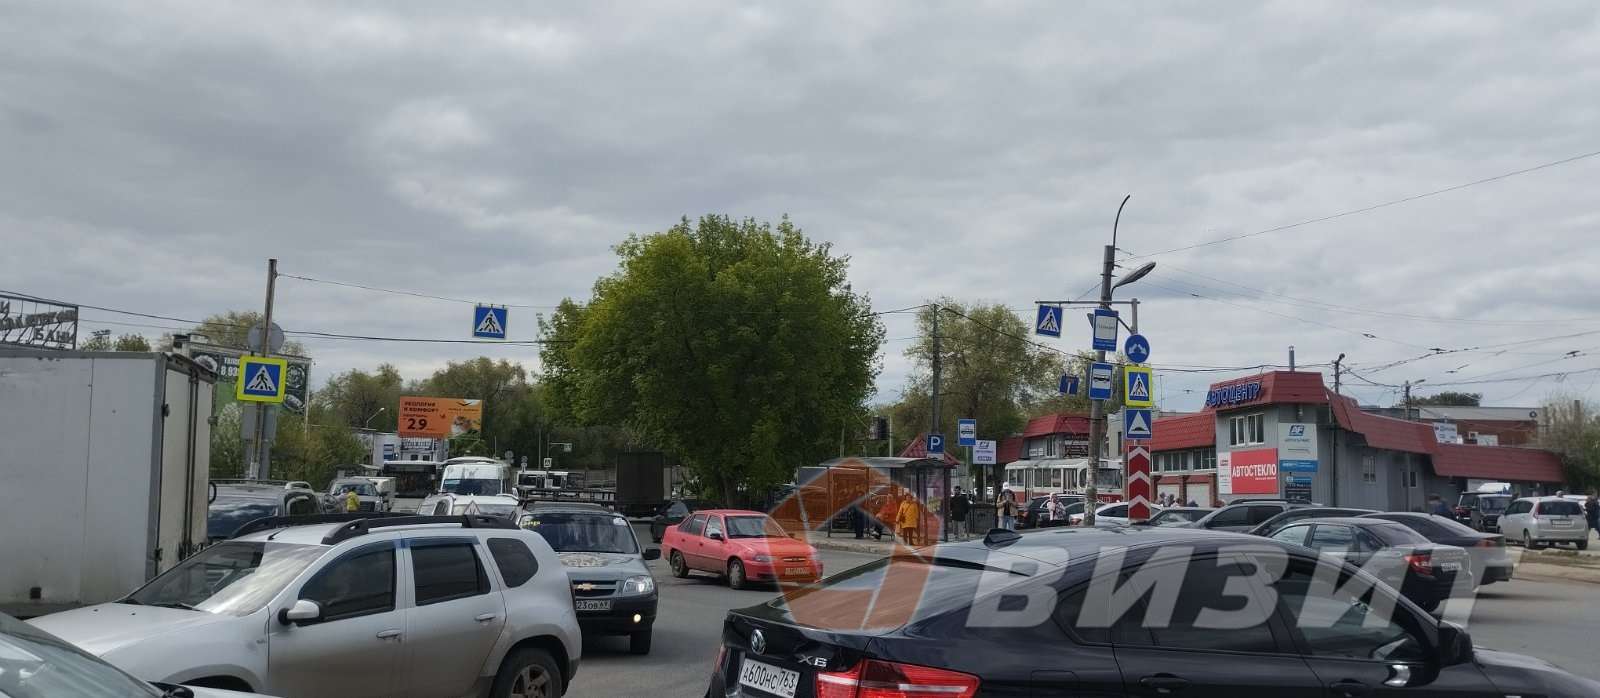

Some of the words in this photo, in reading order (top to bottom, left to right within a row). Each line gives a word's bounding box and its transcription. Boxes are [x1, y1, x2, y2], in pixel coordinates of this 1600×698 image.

[1206, 381, 1262, 407] АВТОЦЕНТР
[930, 436, 941, 450] P
[1232, 463, 1277, 478] АВТОСТЕКЛО
[798, 655, 828, 667] X6
